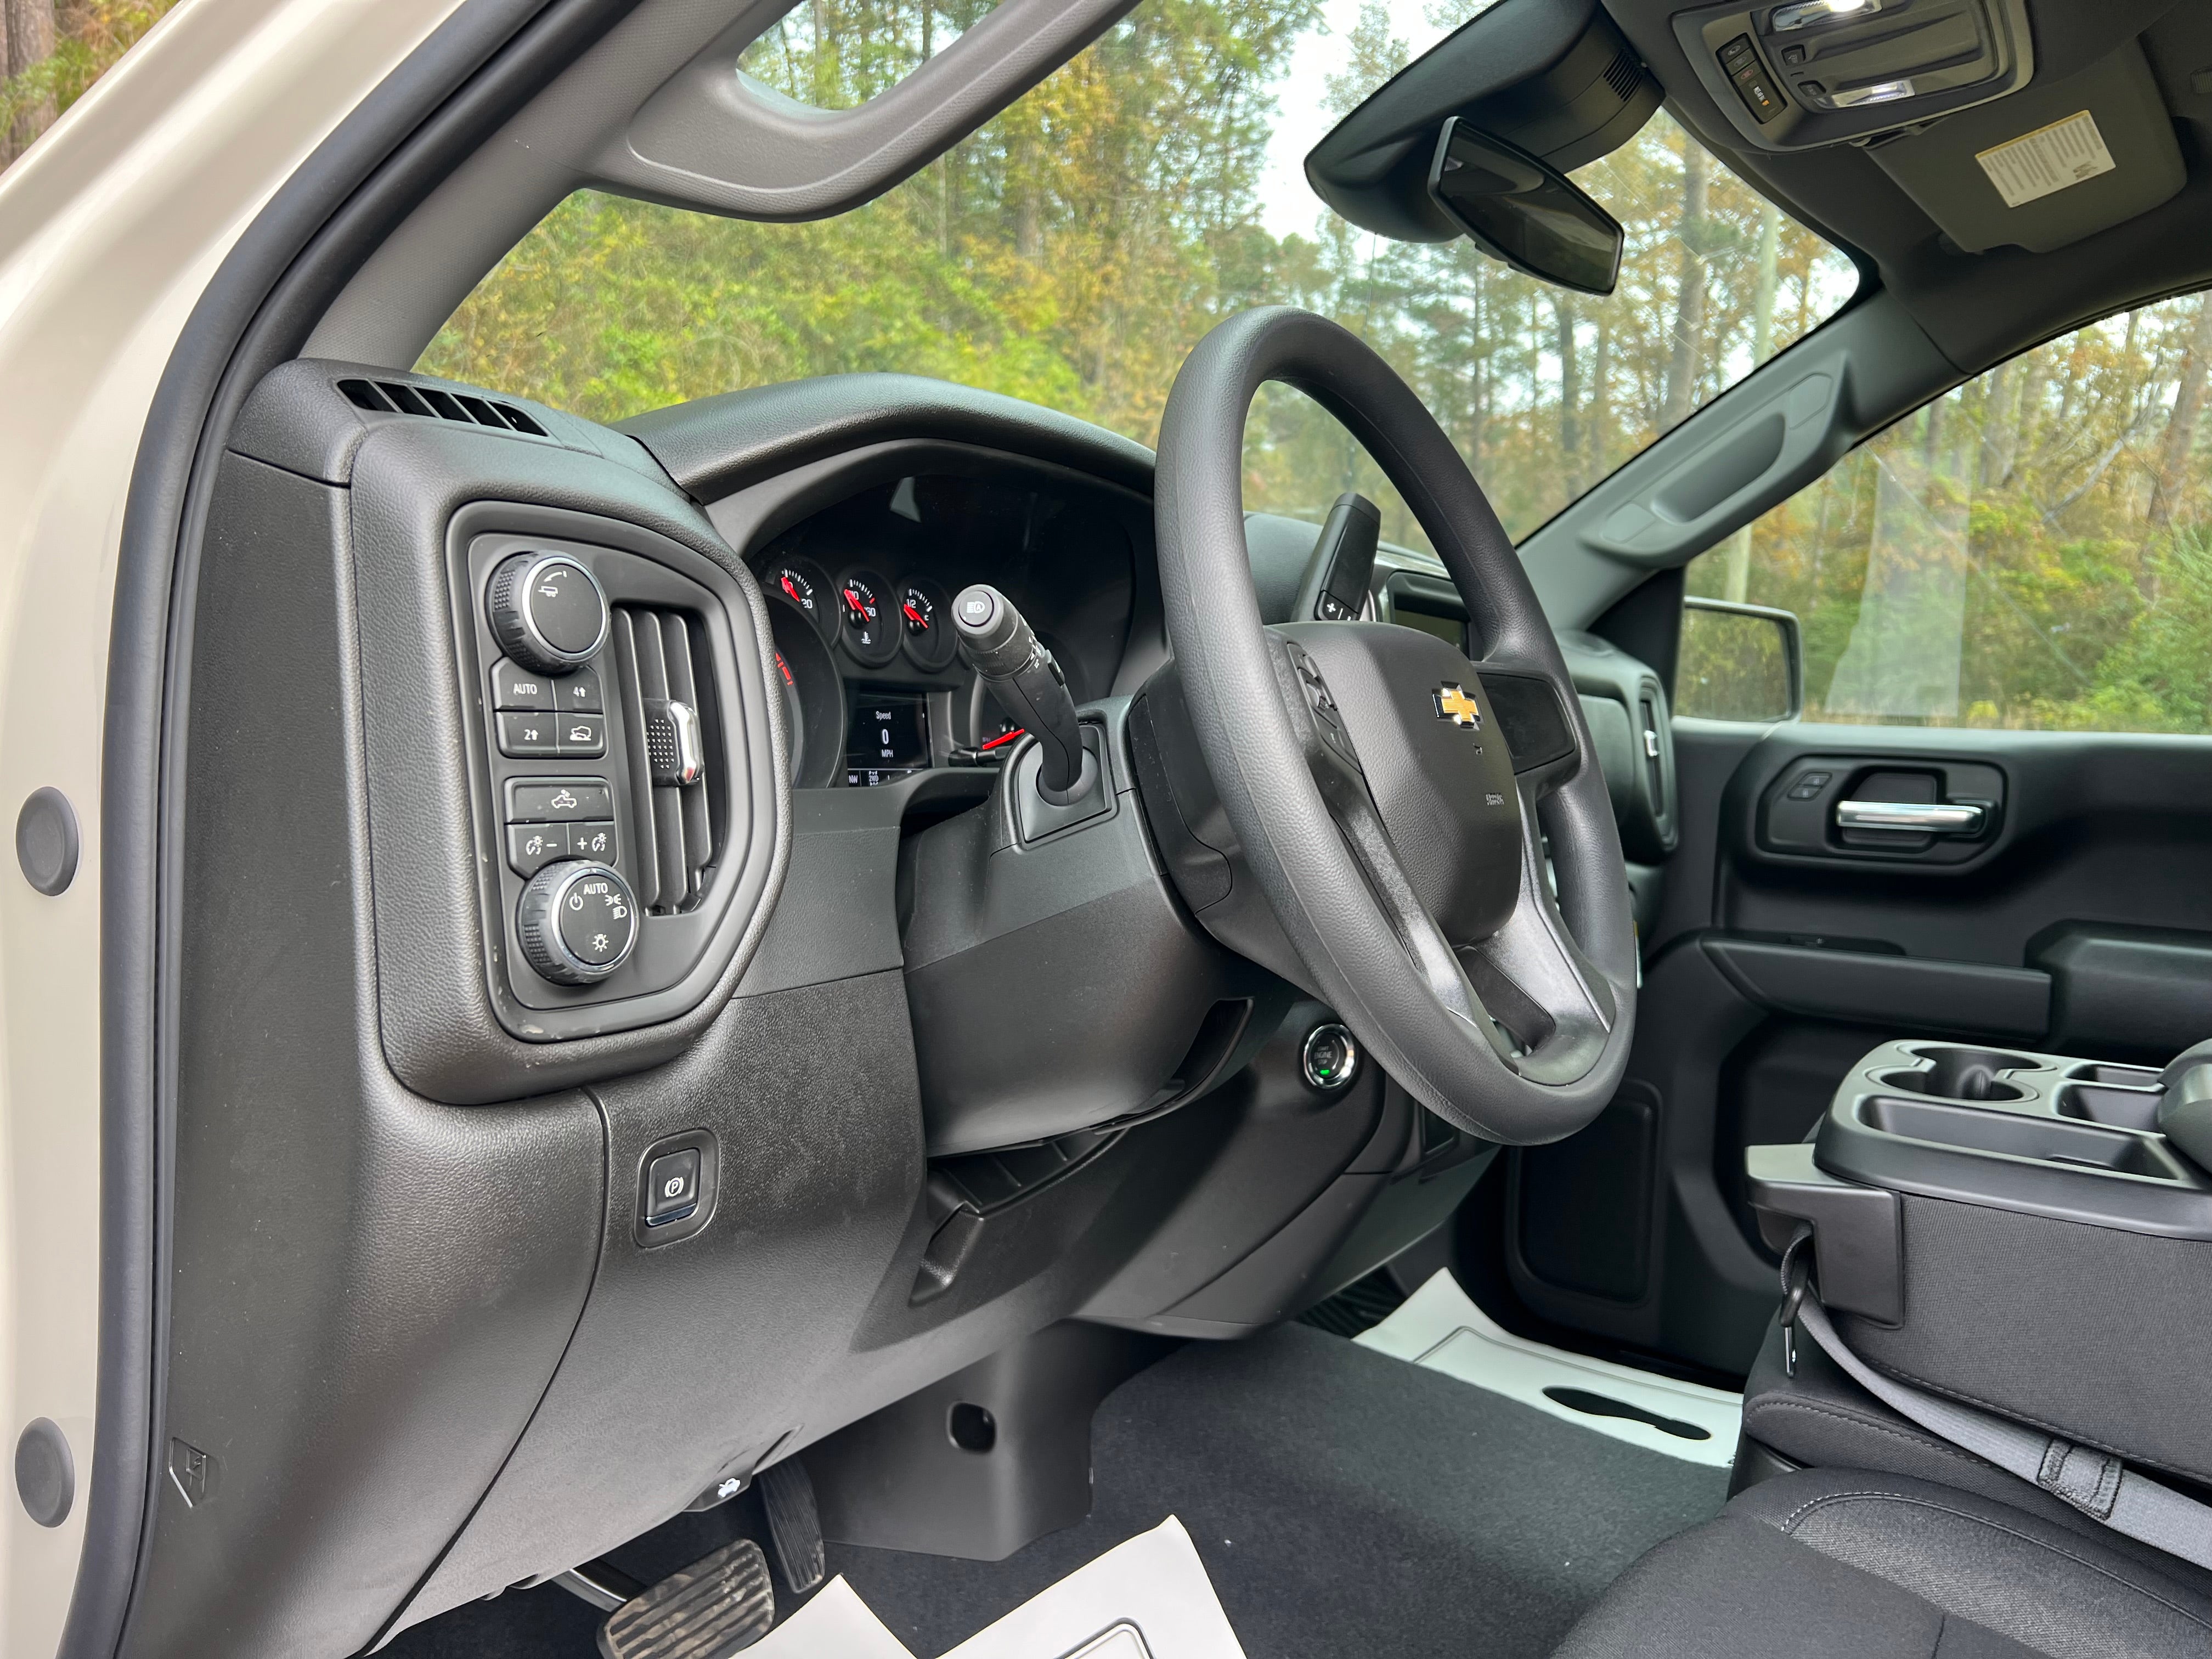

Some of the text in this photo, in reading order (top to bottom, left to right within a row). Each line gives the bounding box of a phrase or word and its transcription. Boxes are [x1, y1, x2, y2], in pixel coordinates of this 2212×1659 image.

[514, 684, 538, 695] AUTO
[876, 710, 891, 720] Speed
[882, 729, 889, 744] 0
[881, 749, 894, 758] MPH
[849, 775, 858, 783] NW
[583, 882, 608, 895] AUTO
